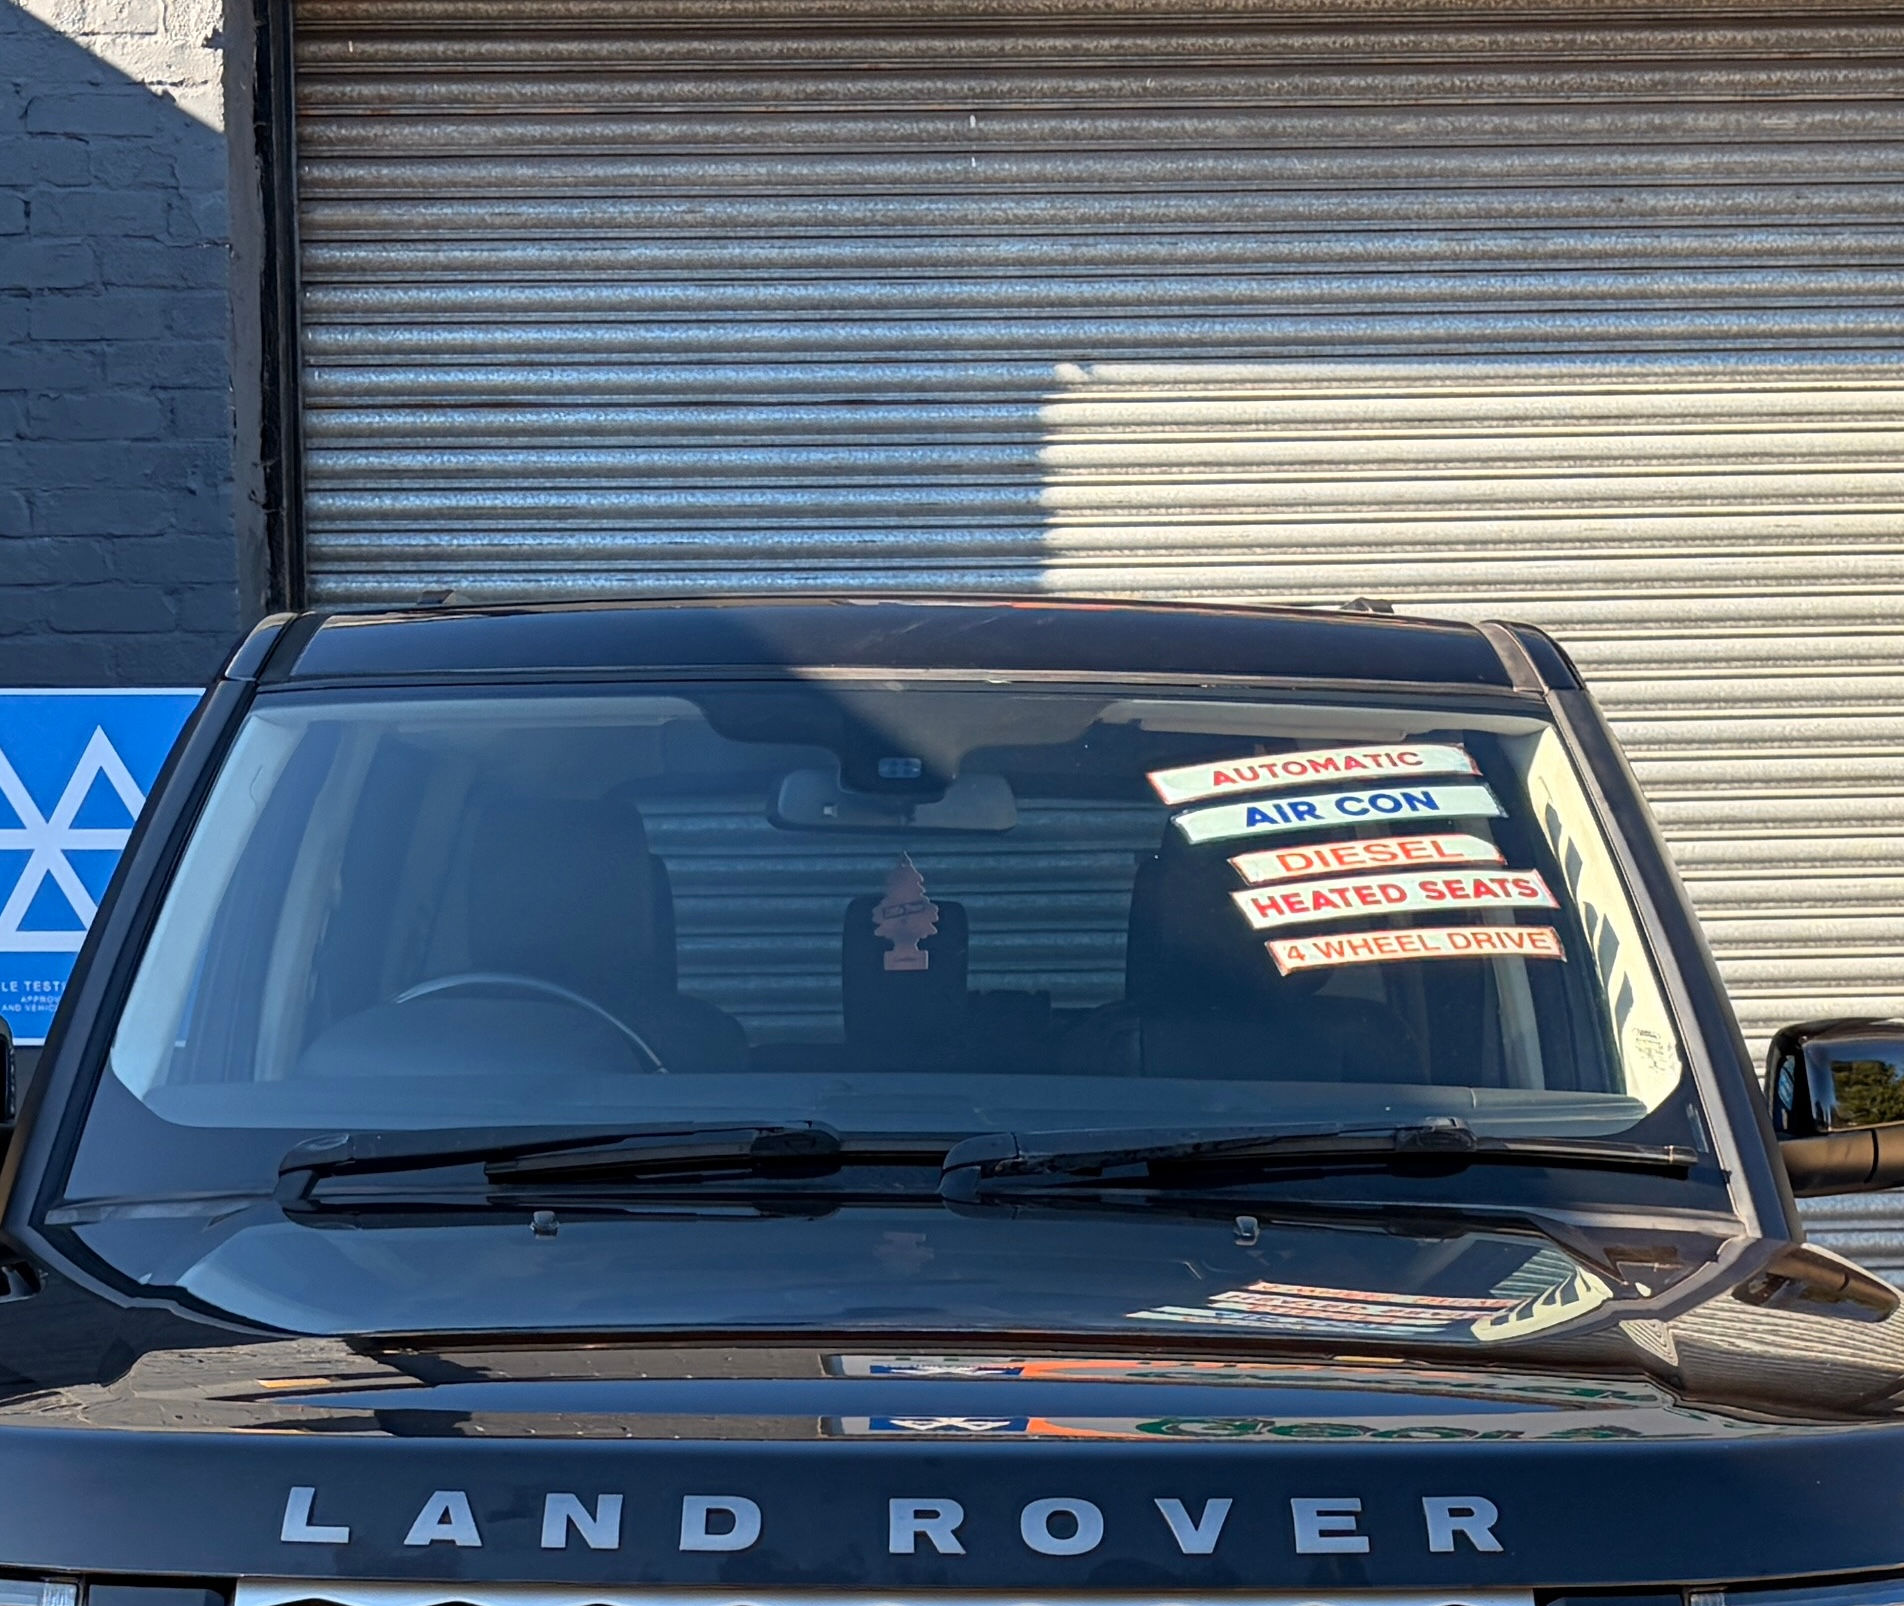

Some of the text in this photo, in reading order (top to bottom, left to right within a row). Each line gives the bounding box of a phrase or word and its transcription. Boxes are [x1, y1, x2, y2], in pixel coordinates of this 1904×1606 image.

[1212, 751, 1425, 787] AUTOMATIC
[1245, 791, 1440, 828] AIR CON
[1275, 840, 1465, 873] DIESEL
[1251, 877, 1540, 919] HEATED SEATS
[1286, 931, 1553, 962] 4 WHEEL DRIVE
[23, 981, 66, 992] TEST
[280, 1486, 1505, 1556] LAND ROVER
